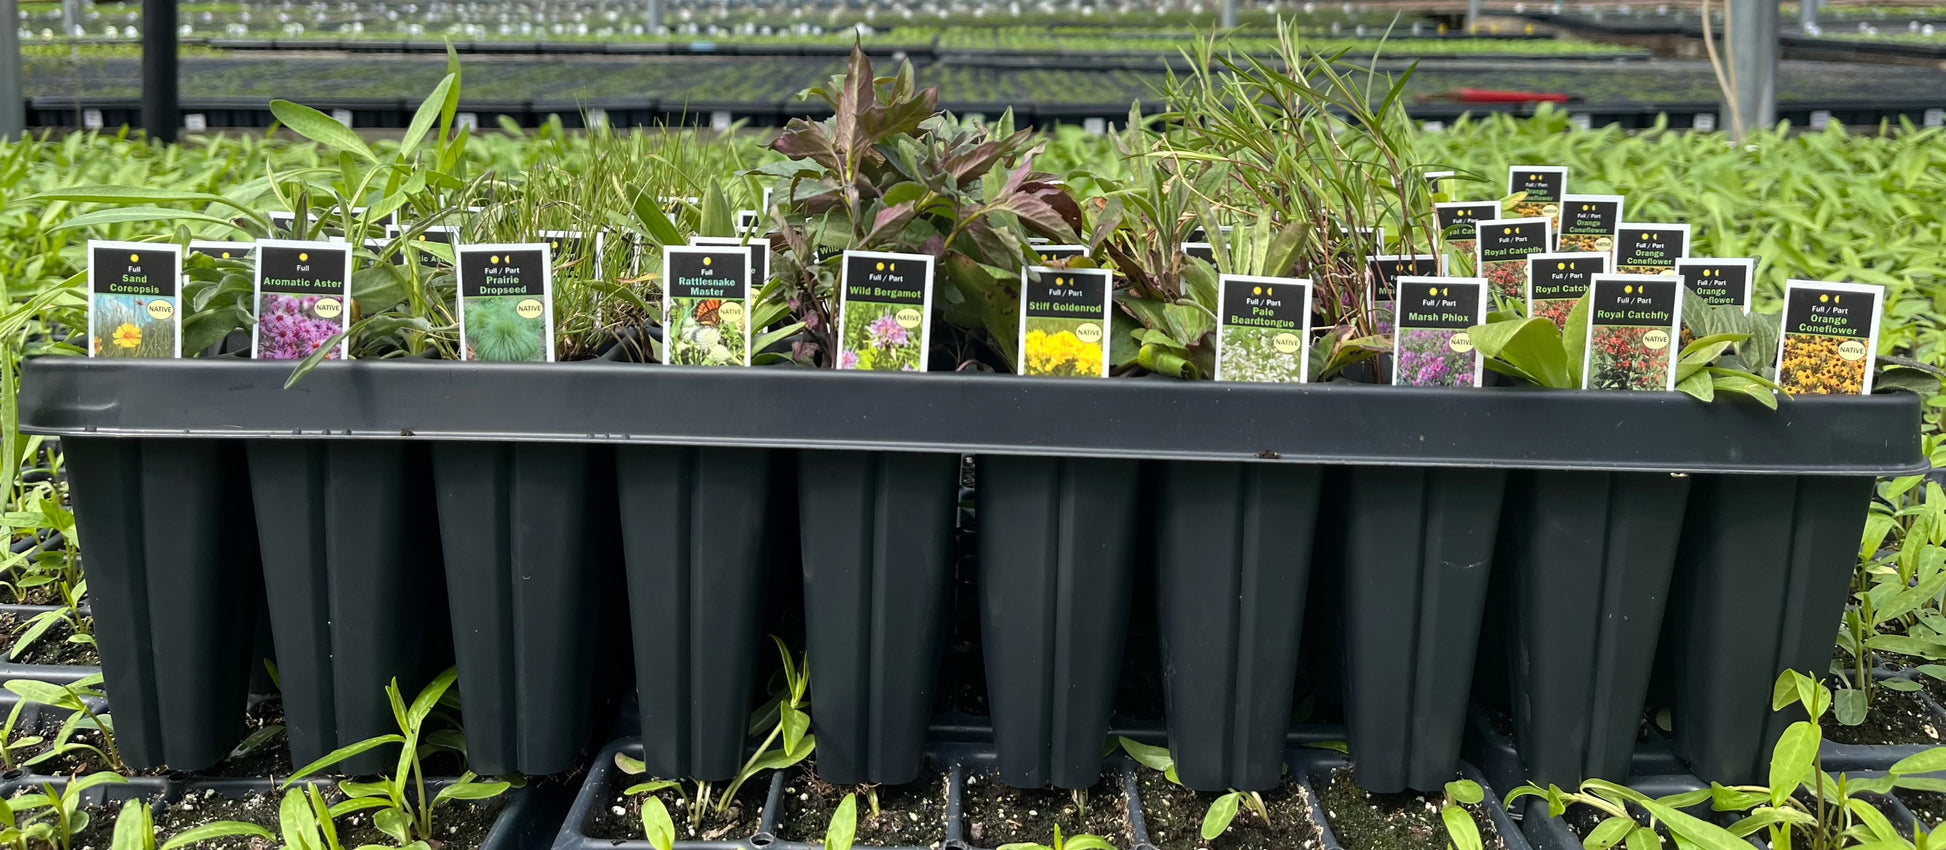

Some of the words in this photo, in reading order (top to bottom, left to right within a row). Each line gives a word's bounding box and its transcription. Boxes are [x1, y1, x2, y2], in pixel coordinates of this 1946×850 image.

[1484, 248, 1506, 256] Royal
[1509, 246, 1542, 254] Catchfly
[122, 274, 147, 283] Sand
[264, 277, 310, 286] Aromatic
[314, 279, 342, 288] Aster
[486, 276, 519, 284] Prairie
[678, 277, 736, 286] Rattlesnake
[110, 283, 159, 294] Coreopsis
[480, 285, 527, 295] Dropseed
[690, 287, 724, 296] Master
[849, 286, 871, 295] Wild
[874, 288, 921, 298] Bergamot
[1536, 286, 1559, 294] Royal
[1697, 288, 1726, 296] Orange
[1029, 302, 1050, 310] Stiff
[1053, 303, 1101, 312] Goldenrod
[1252, 307, 1274, 316] Pale
[1408, 312, 1438, 321] Marsh
[1442, 313, 1469, 322] Phlox
[1597, 310, 1624, 319] Royal
[1628, 311, 1669, 320] Catchfly
[1811, 314, 1847, 326] Orange
[1231, 315, 1294, 328] Beardtongue
[1799, 323, 1857, 335] Coneflower
